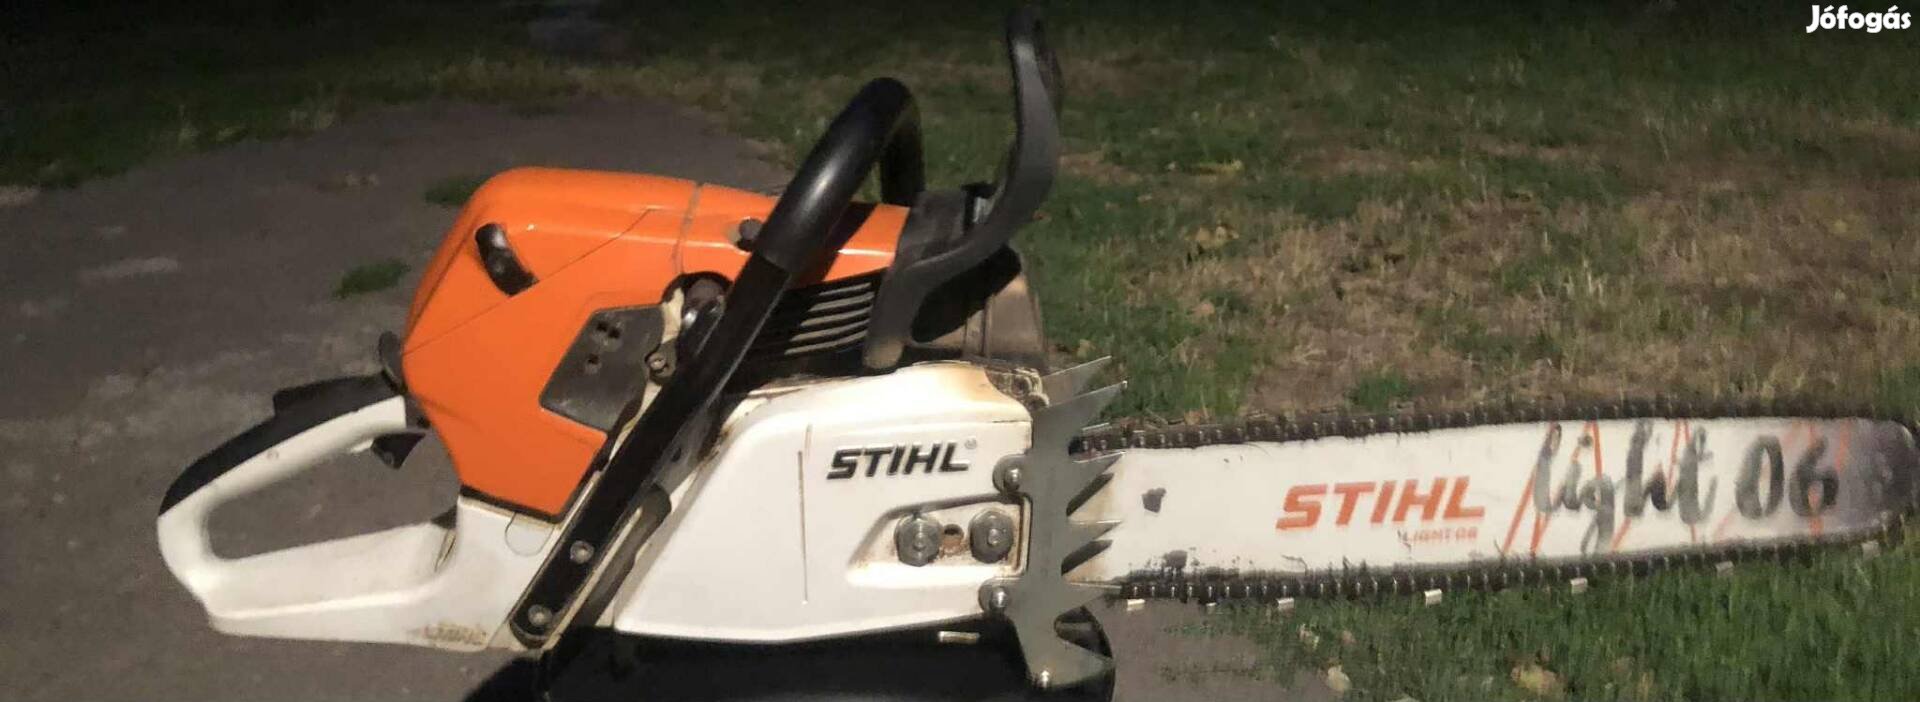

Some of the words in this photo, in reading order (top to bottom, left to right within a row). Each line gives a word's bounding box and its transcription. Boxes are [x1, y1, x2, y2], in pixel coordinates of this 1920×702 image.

[826, 442, 969, 480] STIHL
[1533, 418, 1718, 554] light
[1735, 435, 1839, 520] 06
[1275, 475, 1486, 530] STIHL
